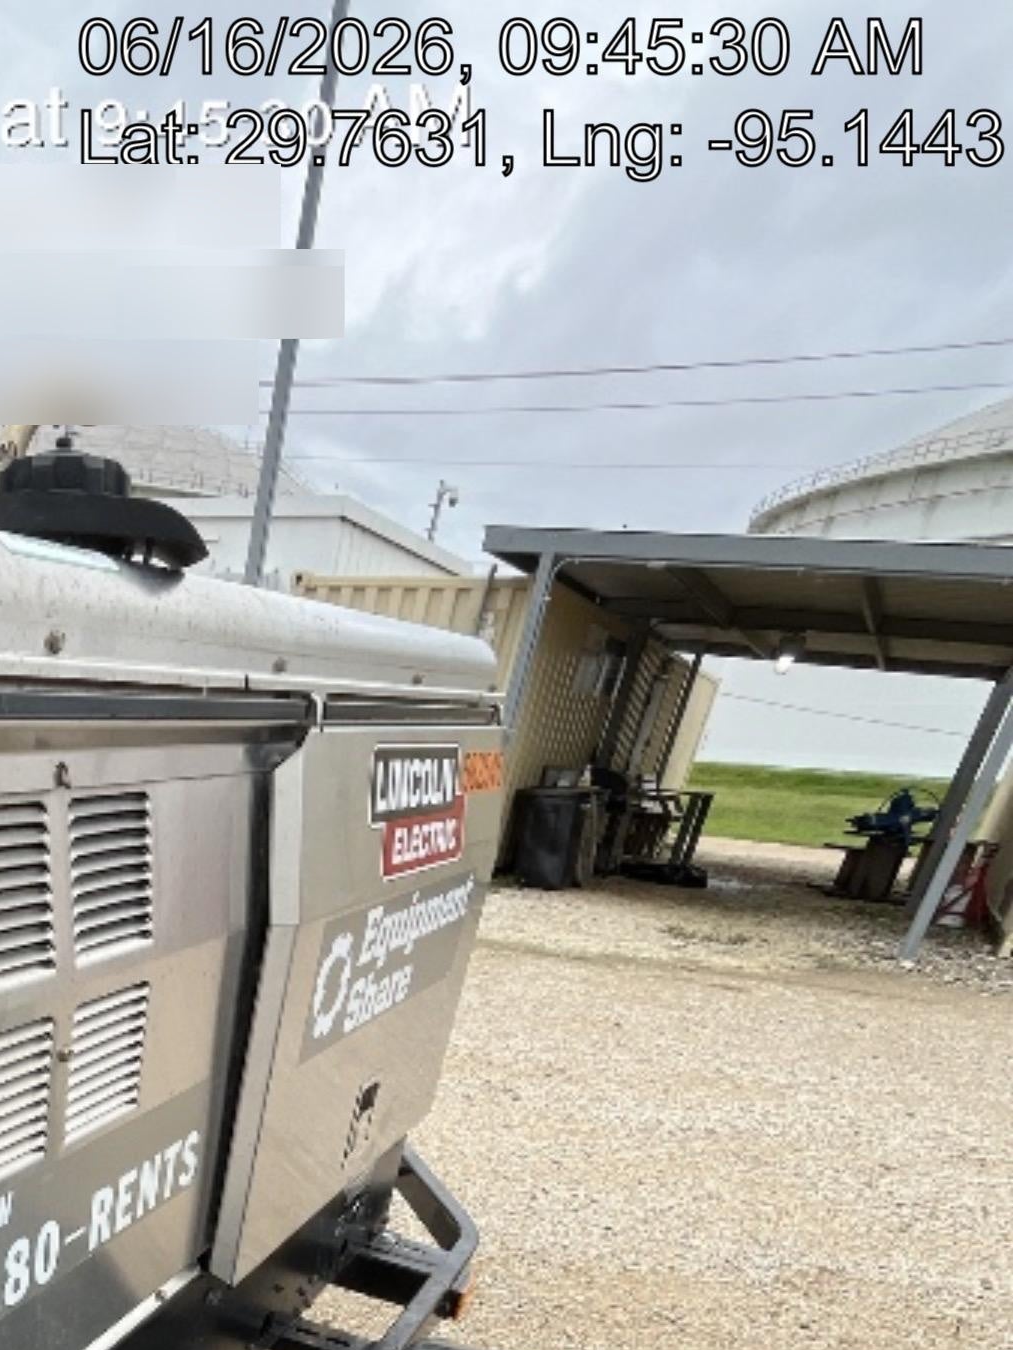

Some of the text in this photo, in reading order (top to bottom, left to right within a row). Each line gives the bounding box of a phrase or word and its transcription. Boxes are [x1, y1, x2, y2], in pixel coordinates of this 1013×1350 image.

[374, 757, 457, 813] LINCOLN
[391, 817, 457, 866] ELECTRIC
[356, 874, 475, 968] Equipment
[344, 963, 414, 1034] Share
